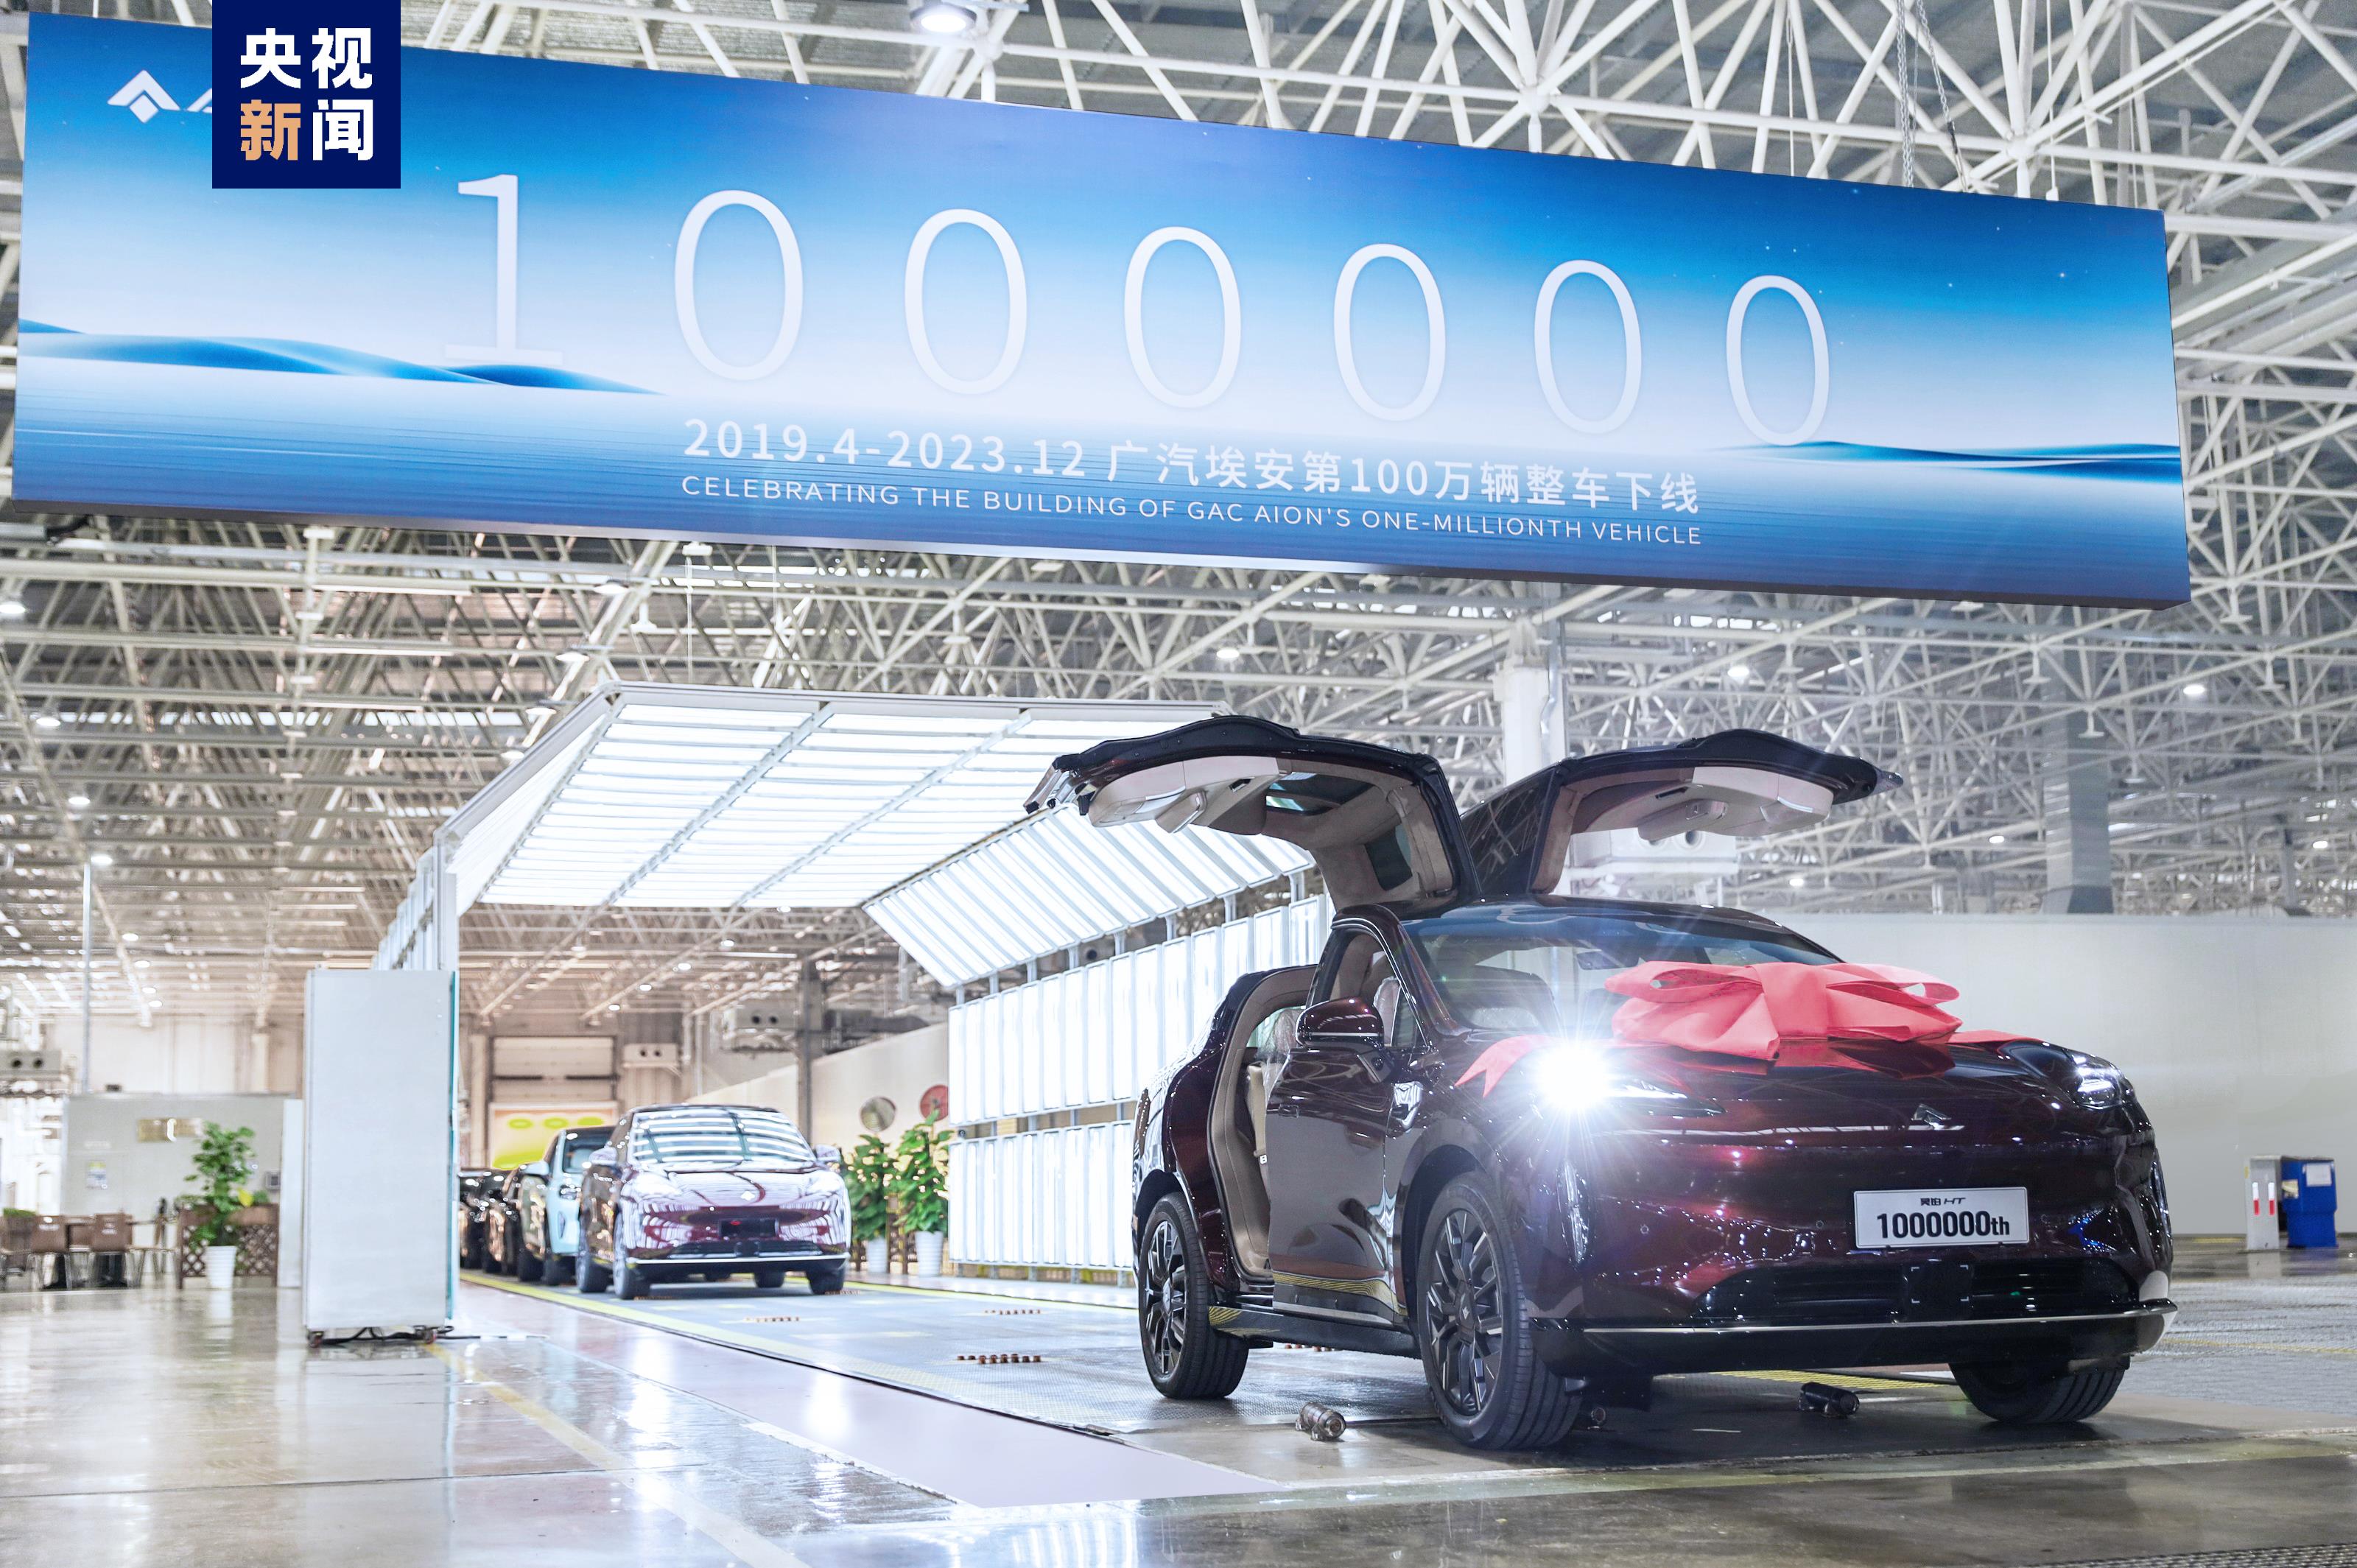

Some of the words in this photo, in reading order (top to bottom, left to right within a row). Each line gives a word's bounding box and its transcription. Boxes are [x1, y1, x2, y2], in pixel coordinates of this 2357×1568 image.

[444, 174, 1830, 446] 1000000
[684, 418, 1086, 477] 2019.4-2023.12
[1107, 440, 1700, 515] 广汽埃安第100万辆整车下线
[681, 475, 899, 505] CELEBRATING
[911, 487, 970, 509] THE
[984, 491, 1127, 516] BUILDING
[1139, 499, 1176, 518] OF
[1187, 501, 1243, 522] GAC
[1254, 505, 1351, 528] AION'S
[1362, 510, 1581, 540] ONE-MILLIONTH
[1592, 522, 1701, 545] VEHICLE
[1877, 1210, 2010, 1239] 1000000th
[1944, 1197, 1966, 1205] HT
